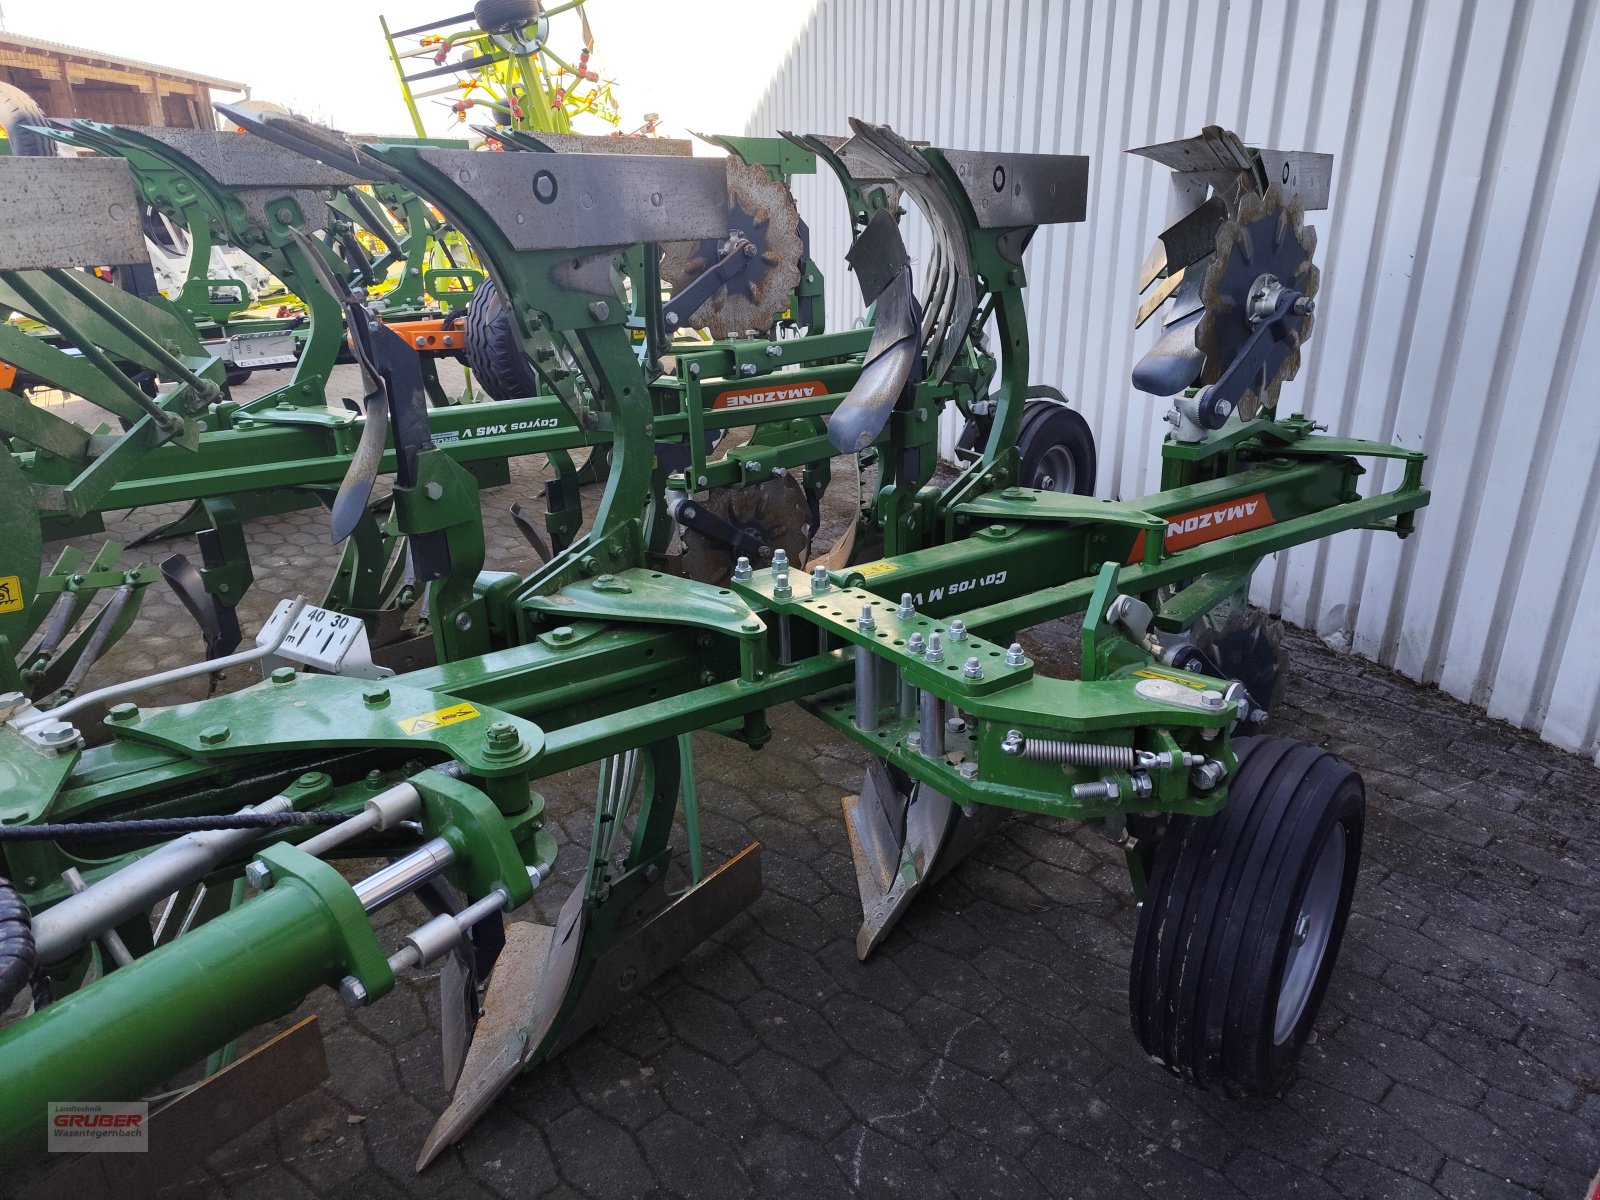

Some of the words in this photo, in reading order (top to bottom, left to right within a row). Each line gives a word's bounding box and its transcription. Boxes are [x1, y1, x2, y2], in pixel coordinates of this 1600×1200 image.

[726, 386, 815, 407] AMAZONE
[476, 423, 508, 437] XMS
[510, 418, 559, 431] Cayros
[461, 428, 473, 438] V
[1166, 500, 1259, 538] AMAZON
[912, 592, 924, 606] V
[927, 585, 945, 603] M
[307, 608, 326, 623] 40
[330, 614, 350, 630] 30
